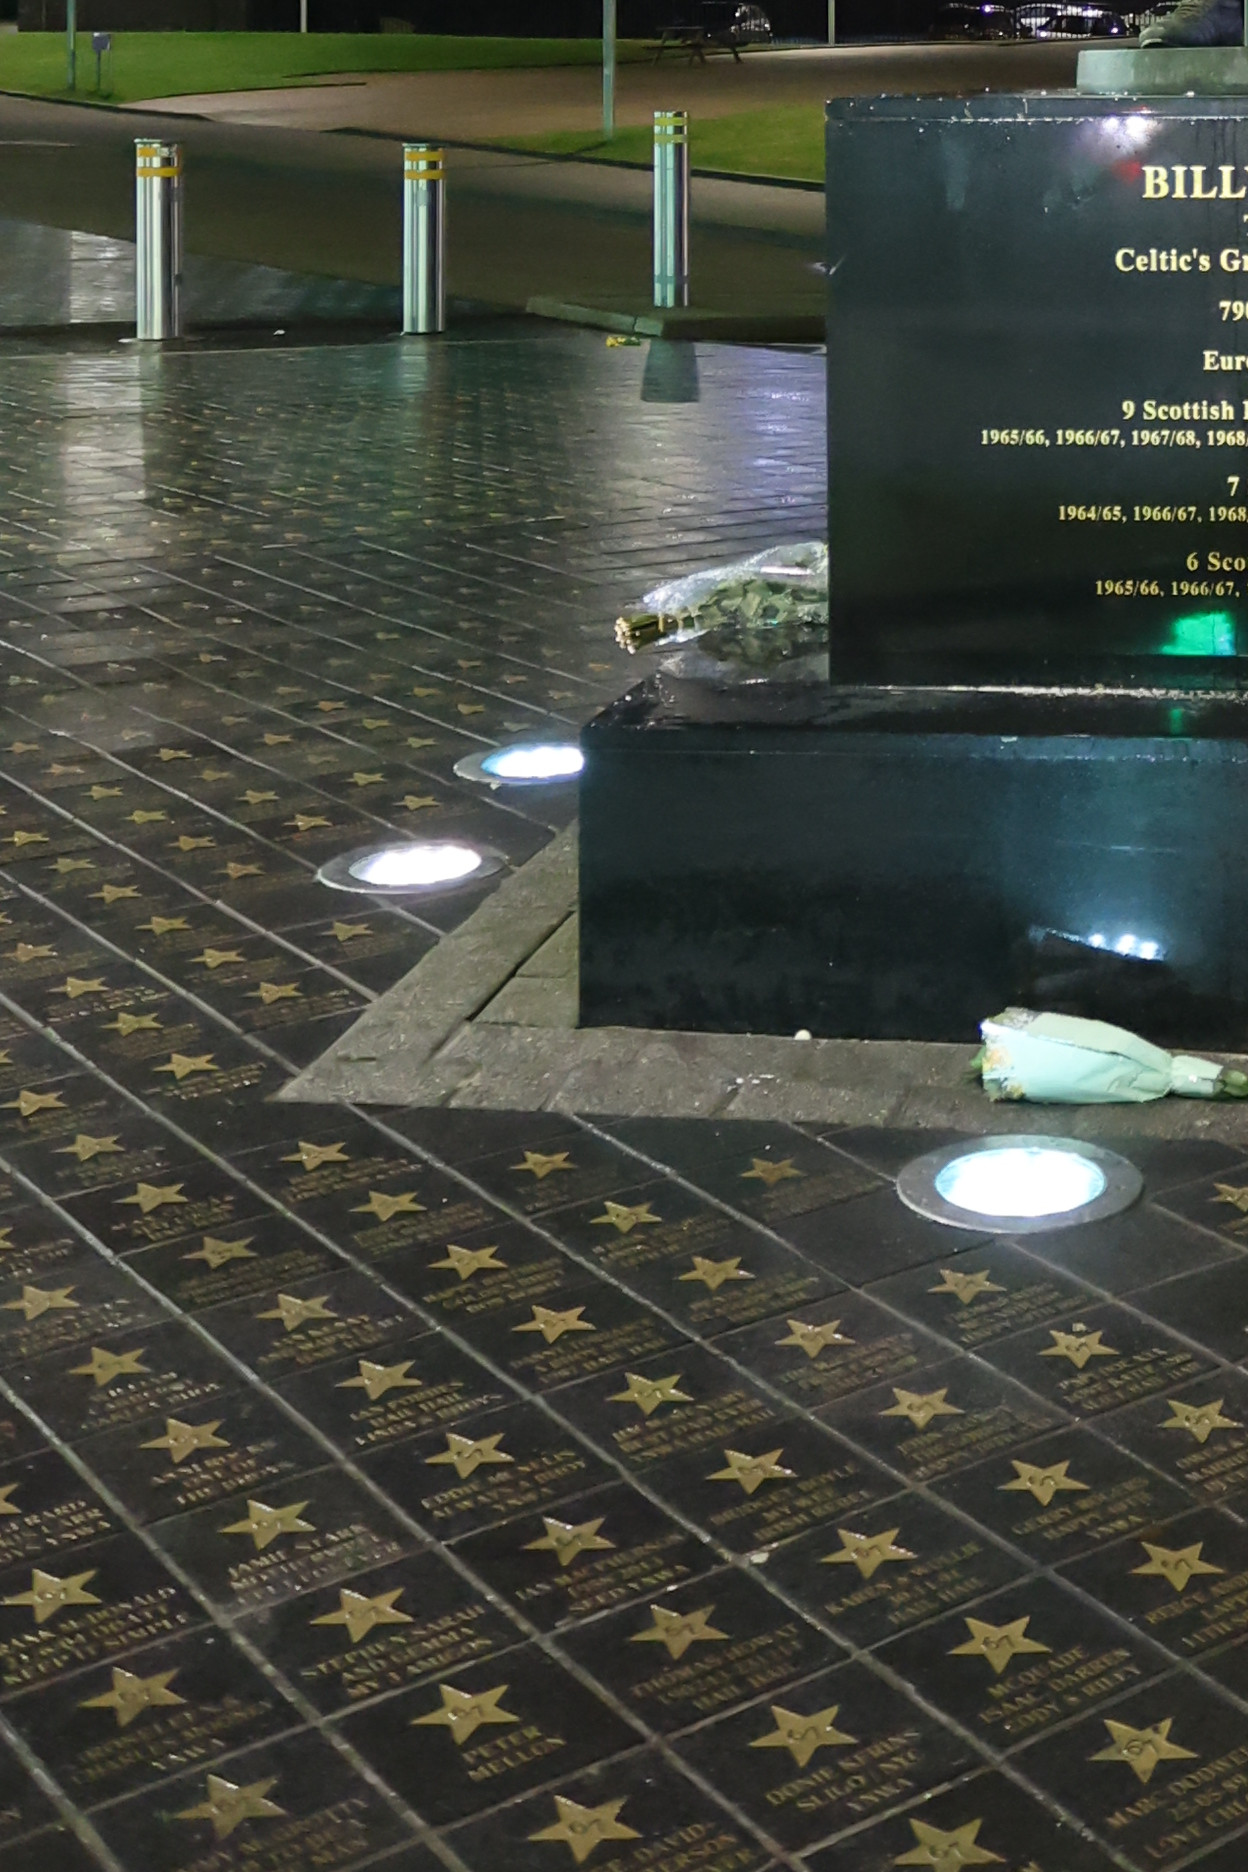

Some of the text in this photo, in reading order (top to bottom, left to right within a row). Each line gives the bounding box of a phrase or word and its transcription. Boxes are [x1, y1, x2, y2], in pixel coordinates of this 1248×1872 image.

[1114, 247, 1211, 272] Celtic's
[1121, 400, 1136, 420] 9
[1142, 399, 1235, 421] Scottish
[981, 429, 1051, 448] 1965/66,
[1055, 428, 1126, 448] 1966/67,
[1131, 429, 1202, 449] 1967/68,
[1226, 475, 1240, 497] 7
[1058, 505, 1128, 524] 1964/65,
[1133, 505, 1203, 523] 1966/67,
[1186, 551, 1199, 572] 6
[1095, 579, 1165, 597] 1965/66,
[1171, 580, 1240, 598] 1966/67,
[1087, 1513, 1144, 1540] YNWA
[885, 1597, 939, 1623] HAIL
[936, 1577, 986, 1601] HAIL
[629, 1655, 722, 1698] THOMAS
[692, 1662, 798, 1710] HAIL HAIL
[985, 1646, 1092, 1698] MCQUADE
[1044, 1647, 1134, 1691] DARREN
[462, 1725, 544, 1764] PETER
[467, 1735, 568, 1782] MELLON
[794, 1774, 869, 1812] SLIGO
[877, 1748, 924, 1774] NYC
[846, 1777, 915, 1812] YNWA
[1104, 1792, 1170, 1828] MARC
[1142, 1823, 1205, 1858] LOVE
